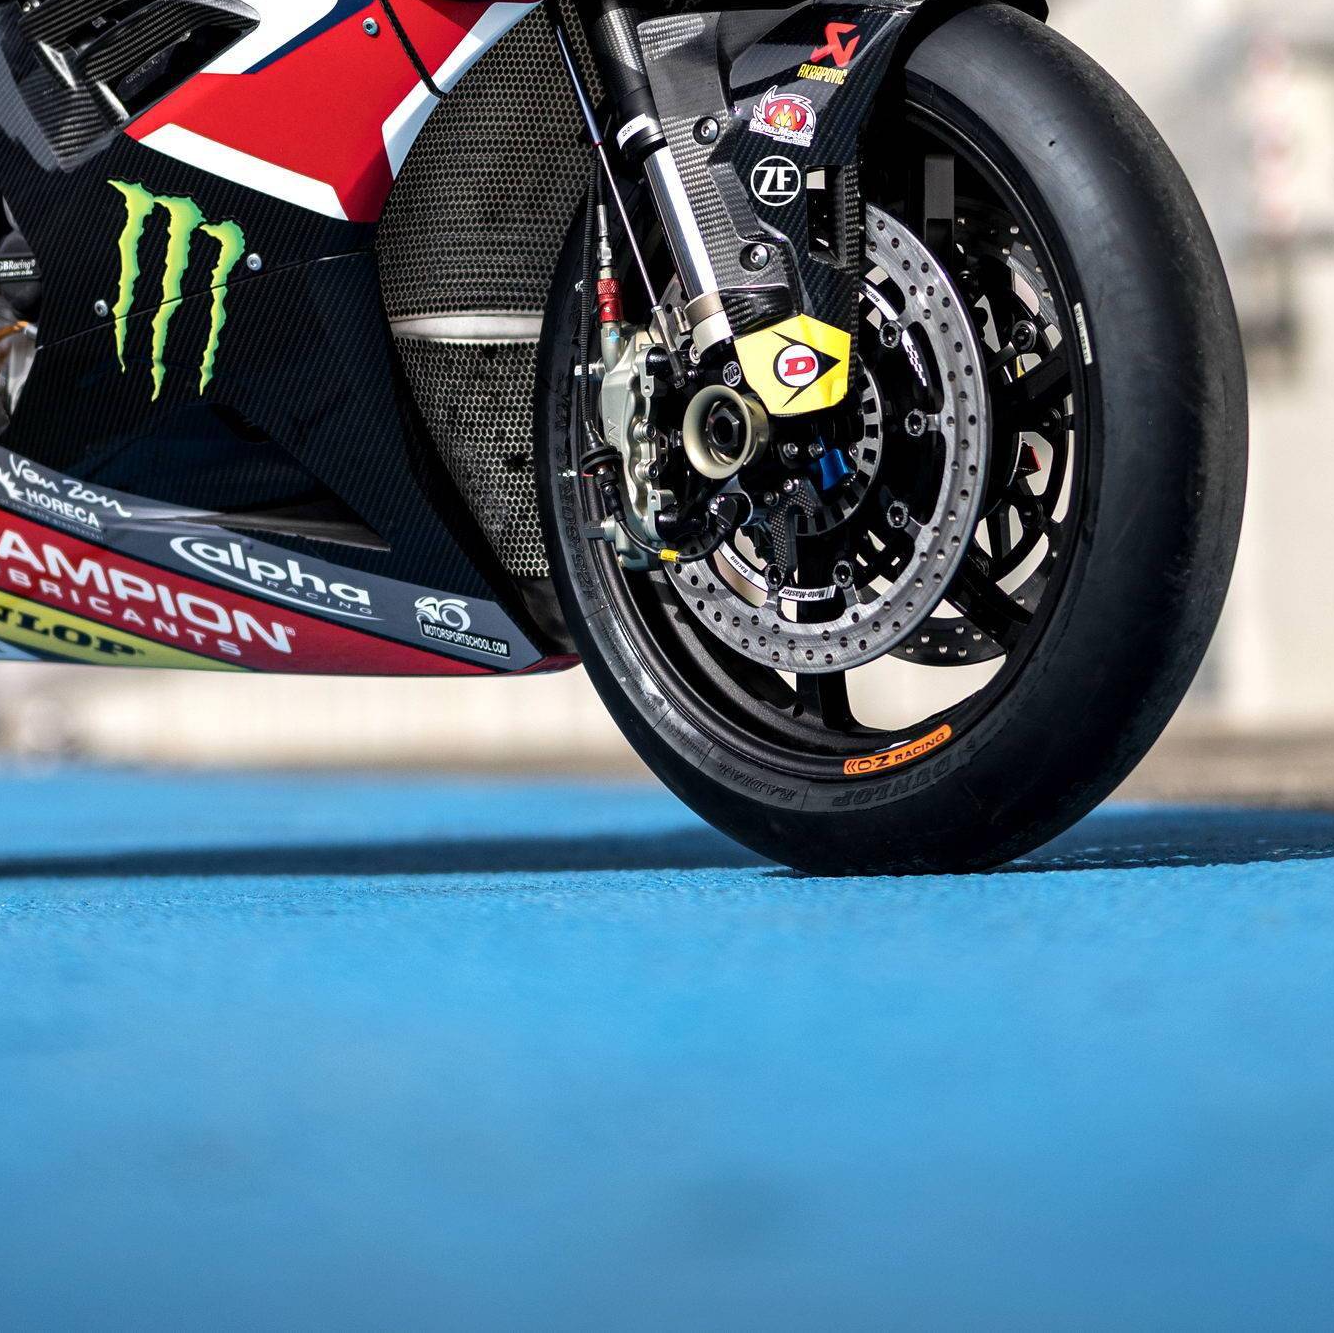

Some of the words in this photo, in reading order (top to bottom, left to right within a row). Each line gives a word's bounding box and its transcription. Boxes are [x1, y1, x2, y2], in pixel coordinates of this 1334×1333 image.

[754, 164, 798, 197] ZF
[784, 356, 816, 376] D
[9, 454, 60, 495] Van
[25, 488, 102, 530] HORECA
[190, 541, 372, 607] alpha
[267, 580, 373, 616] RACING
[782, 588, 826, 599] Moto-Master
[423, 623, 509, 656] MOTORSPORTSCHOOL.COM
[893, 732, 946, 763] RACING
